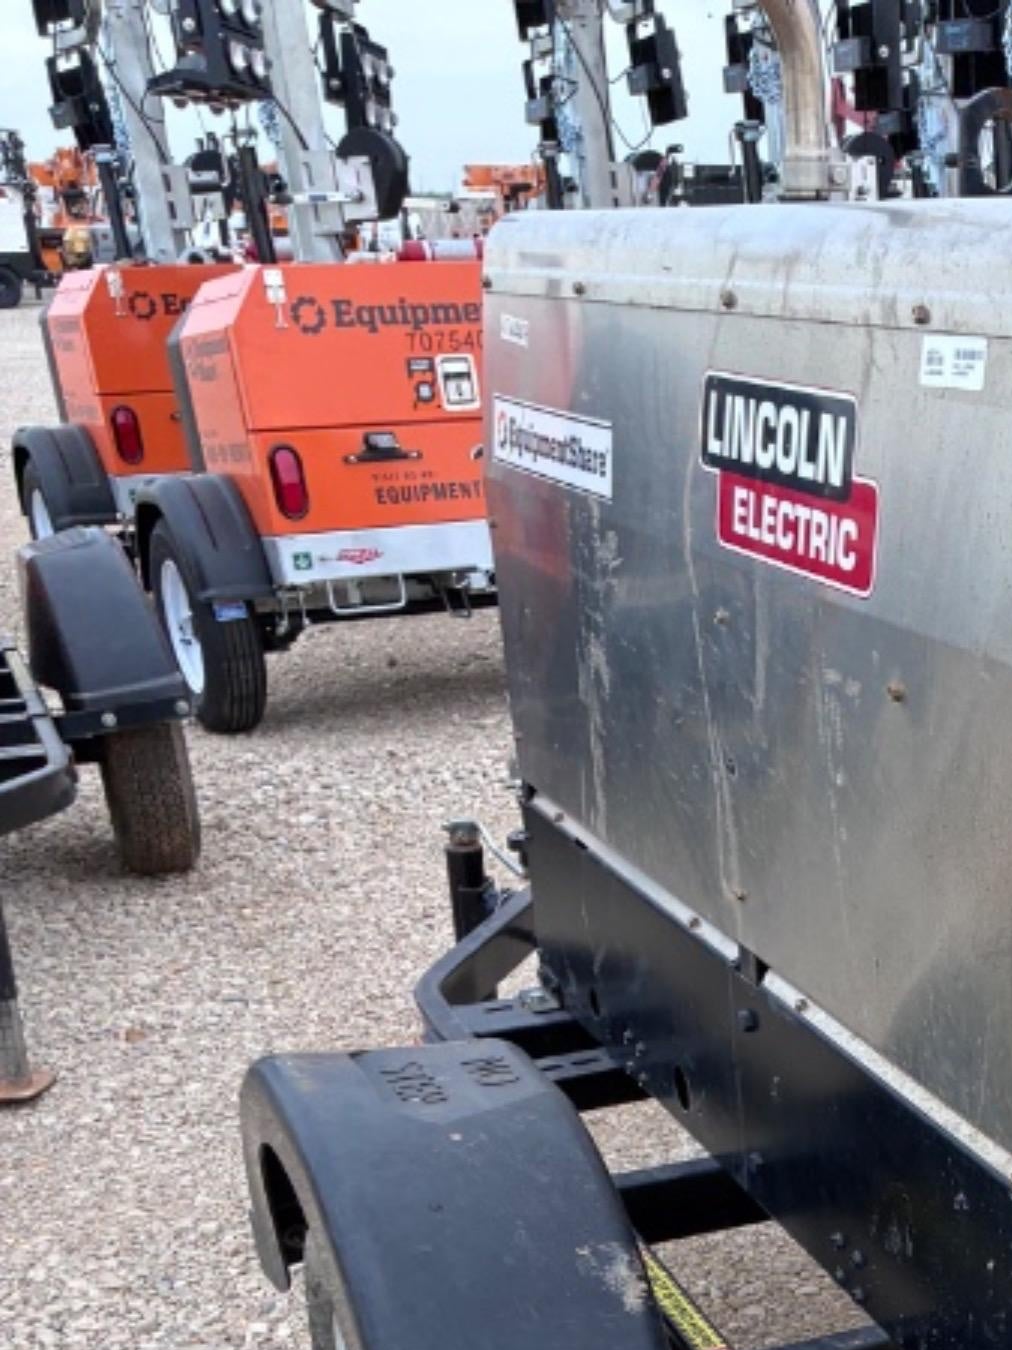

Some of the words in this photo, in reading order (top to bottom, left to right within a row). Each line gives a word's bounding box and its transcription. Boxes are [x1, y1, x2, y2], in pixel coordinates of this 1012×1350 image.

[331, 297, 483, 333] Equipme
[706, 389, 848, 489] LINCOLN
[375, 480, 482, 505] EQUIPMENT
[732, 485, 860, 573] ELECTRIC
